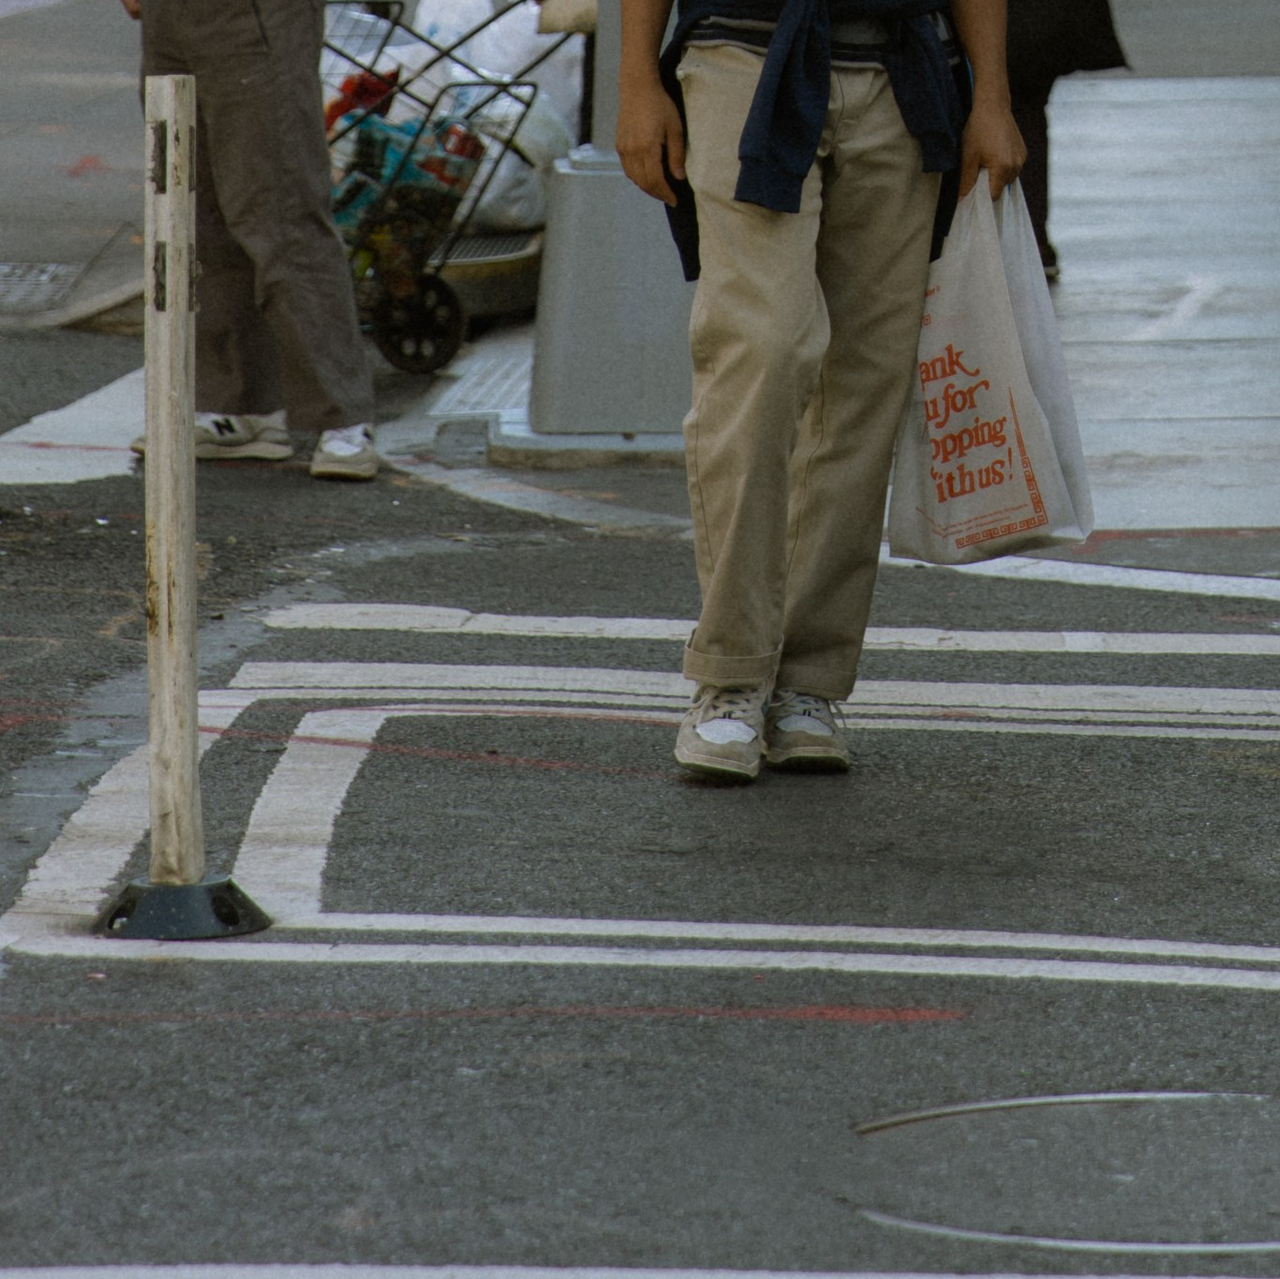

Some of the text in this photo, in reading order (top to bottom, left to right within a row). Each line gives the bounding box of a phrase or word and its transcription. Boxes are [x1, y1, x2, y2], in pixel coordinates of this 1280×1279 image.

[919, 343, 981, 385] ank
[934, 379, 991, 429] for
[929, 461, 976, 504] ith
